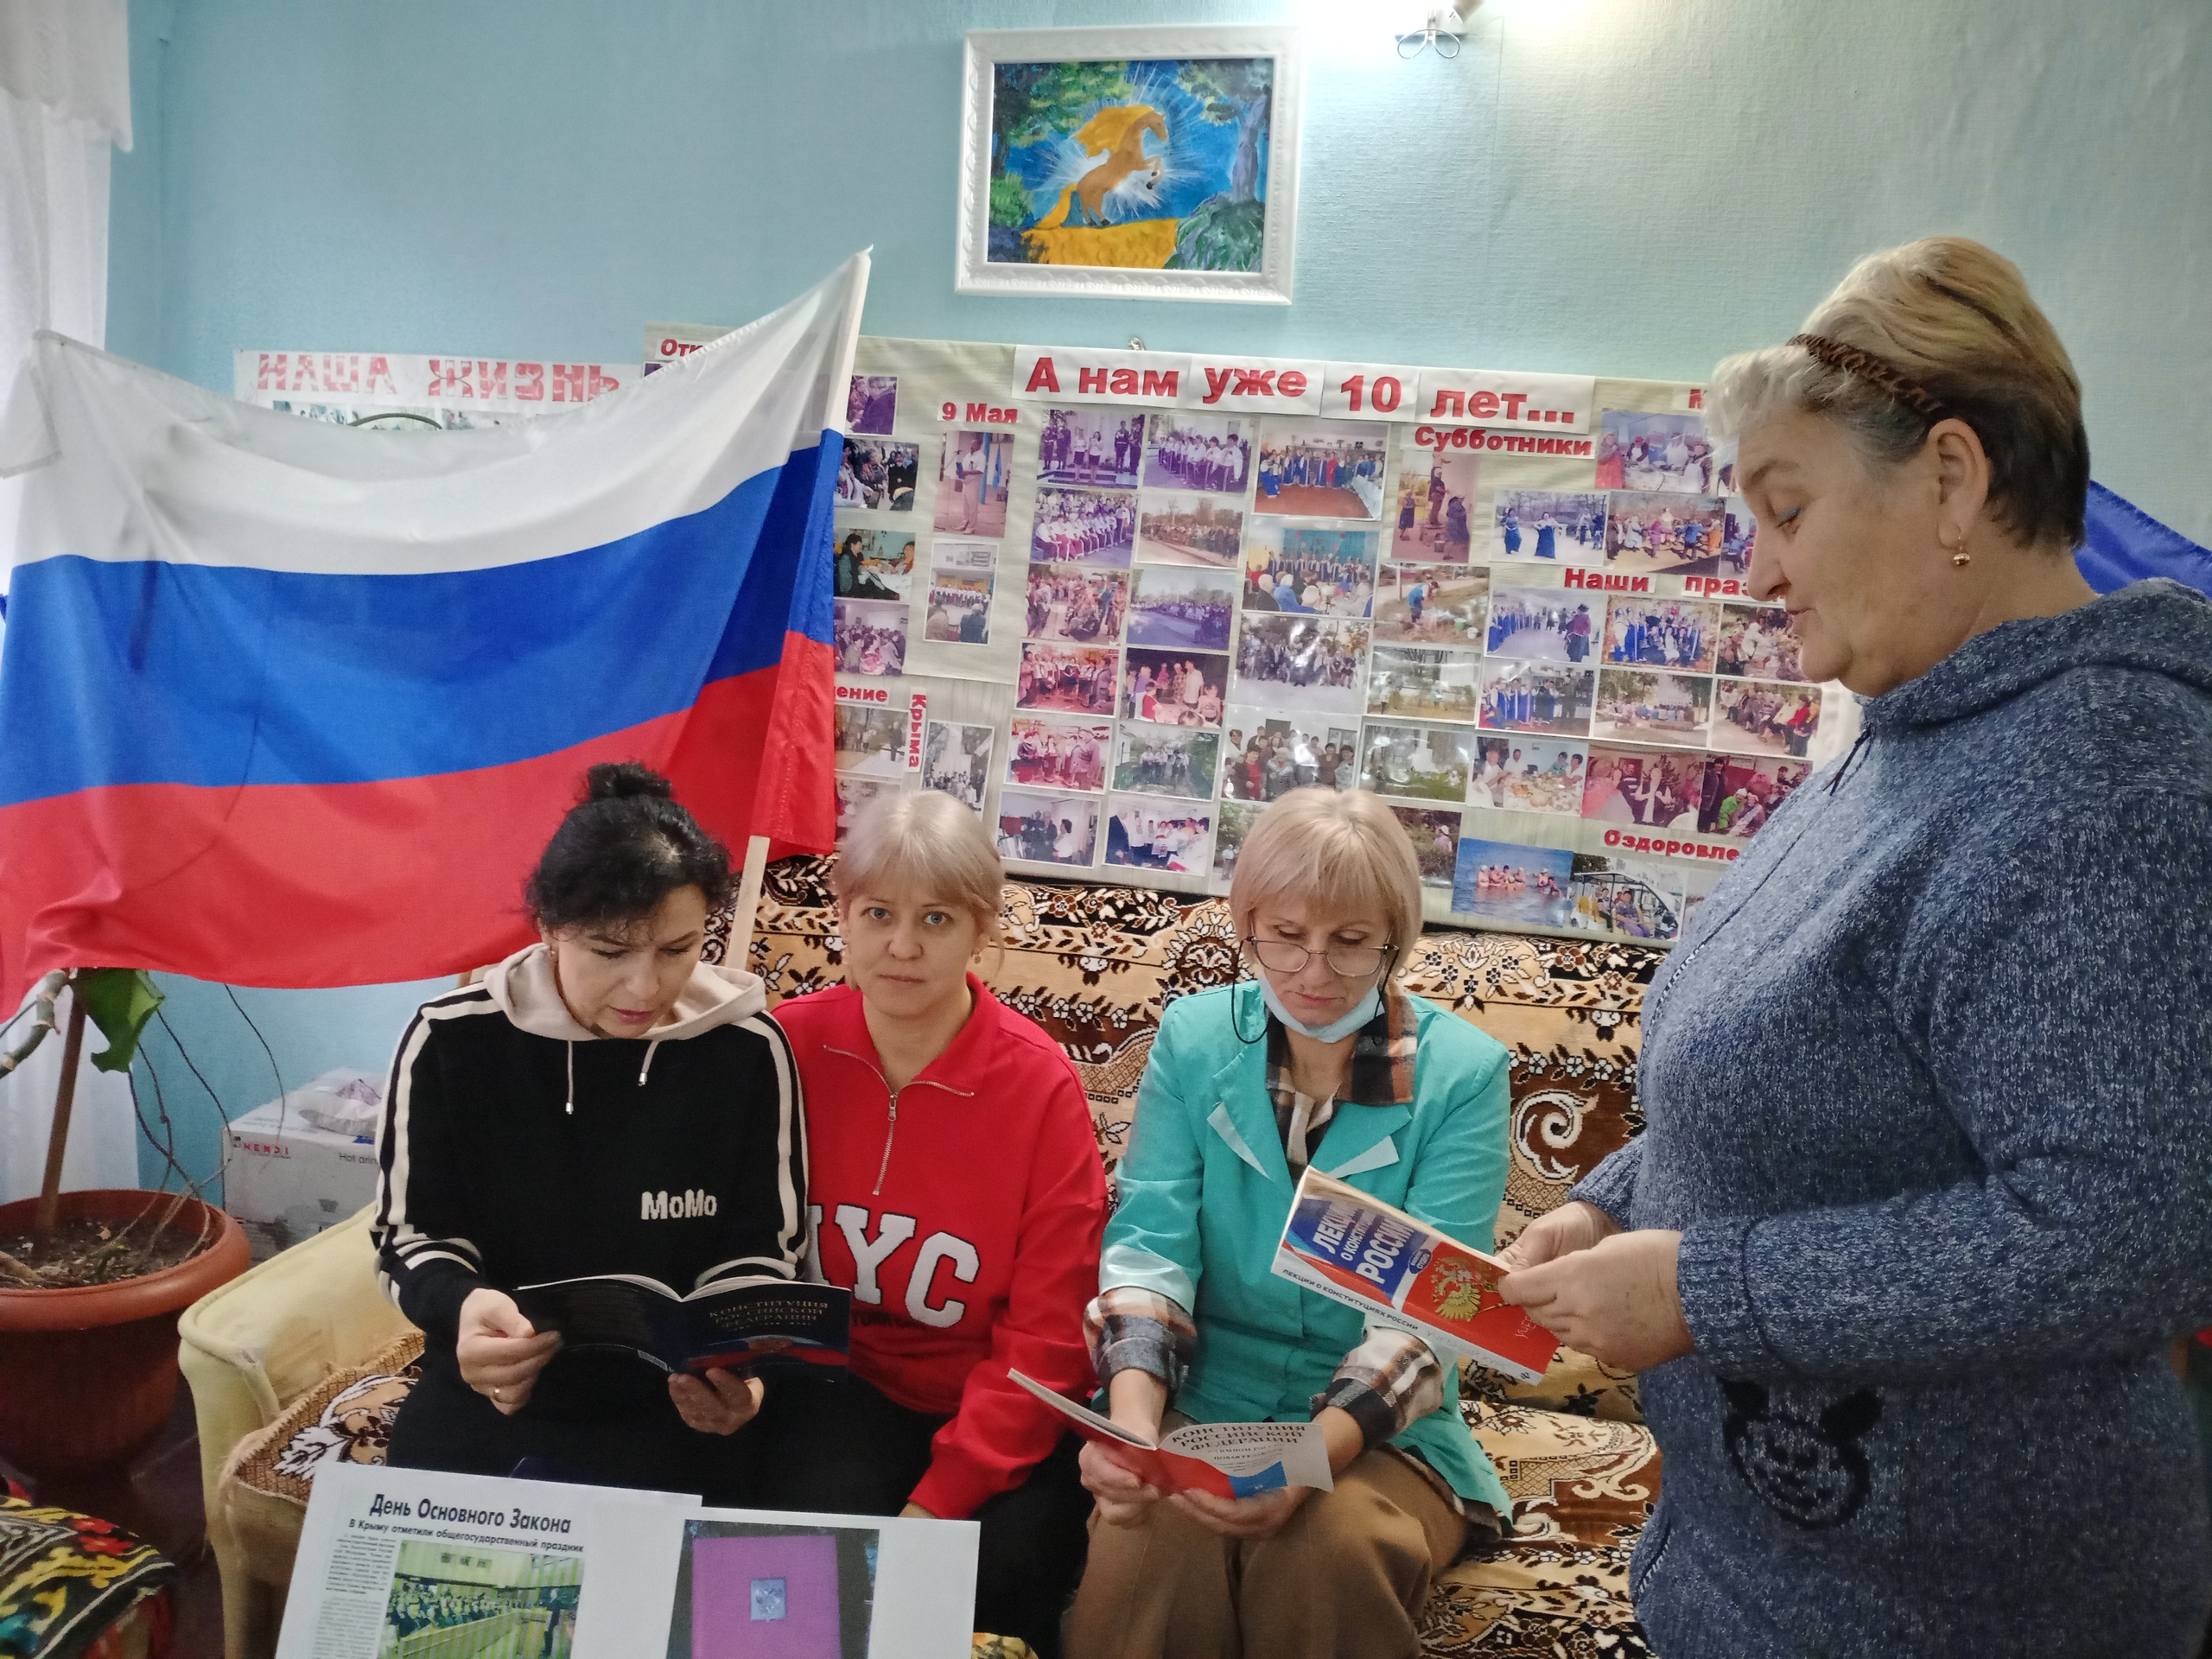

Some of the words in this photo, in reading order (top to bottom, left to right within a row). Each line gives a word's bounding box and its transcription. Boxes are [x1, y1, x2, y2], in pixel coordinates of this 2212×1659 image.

[257, 354, 397, 394] НАША
[428, 359, 620, 403] ЖИЗНЬ
[1025, 356, 1061, 393] А
[1077, 366, 1180, 397] нам
[1202, 366, 1308, 404] уже
[1340, 374, 1402, 413] 10
[1430, 386, 1576, 424] лет...
[941, 401, 957, 422] 9
[965, 402, 1019, 424] Мая
[1414, 425, 1593, 457] Субботники
[1564, 568, 1650, 592] Наши
[834, 685, 888, 702] ение
[908, 694, 926, 768] Крыма
[640, 1188, 717, 1221] MoMo
[1356, 1216, 1415, 1285] РОССИИ
[709, 1300, 829, 1318] КОНСТИТУЦИЯ
[1282, 1268, 1315, 1287] ЛЕКЦИИ
[1323, 1286, 1386, 1317] КОНСТИТУЦИЯХ
[1386, 1313, 1419, 1331] РОССИИ
[1172, 1426, 1306, 1443] КОНСТИТУЦИЯ
[1180, 1431, 1303, 1447] РОССИЙСКОЙ
[1191, 1437, 1299, 1451] ФЕДЕРАЦИИ
[369, 1493, 411, 1517] День
[418, 1498, 505, 1527] Основного
[509, 1508, 571, 1534] Закона
[348, 1518, 357, 1528] В
[358, 1520, 389, 1534] Крыму
[391, 1525, 433, 1536] отметили
[435, 1529, 538, 1548] общегосударственный
[540, 1541, 584, 1553] праздник
